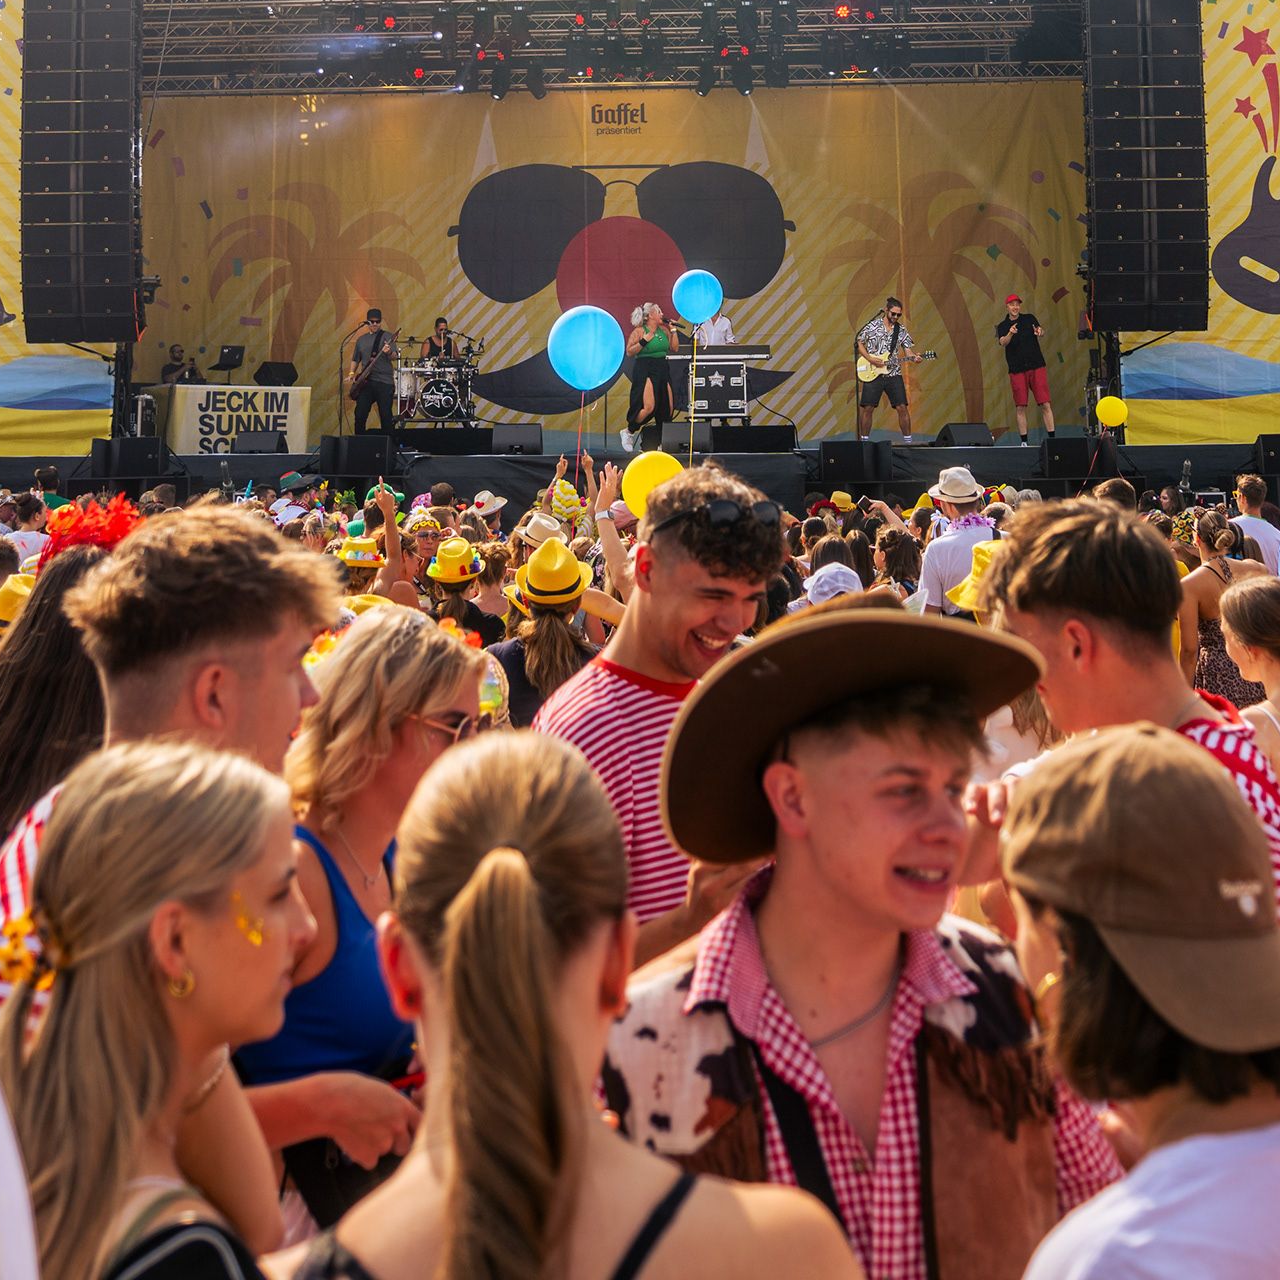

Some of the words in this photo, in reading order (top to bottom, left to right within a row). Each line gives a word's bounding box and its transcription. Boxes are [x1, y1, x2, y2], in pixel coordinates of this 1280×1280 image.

[591, 102, 648, 126] Gaffel
[596, 126, 642, 136] präsentiert
[198, 391, 258, 413] JECK
[264, 392, 289, 413] IM
[198, 414, 288, 435] SUNNE
